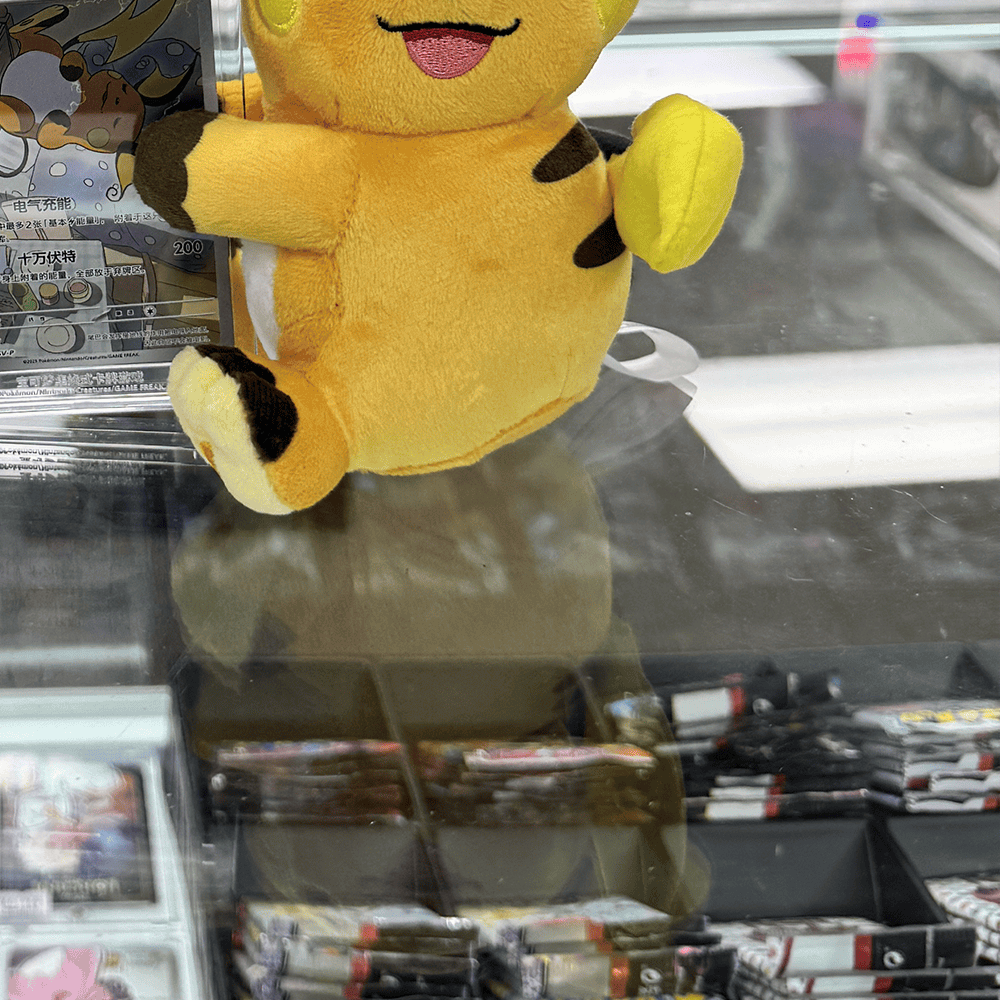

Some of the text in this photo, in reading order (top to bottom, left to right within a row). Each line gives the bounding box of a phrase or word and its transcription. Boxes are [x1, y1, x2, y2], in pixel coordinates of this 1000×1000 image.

[13, 197, 72, 213] 电气充能
[174, 240, 203, 255] 200
[18, 250, 76, 265] 十万伏特
